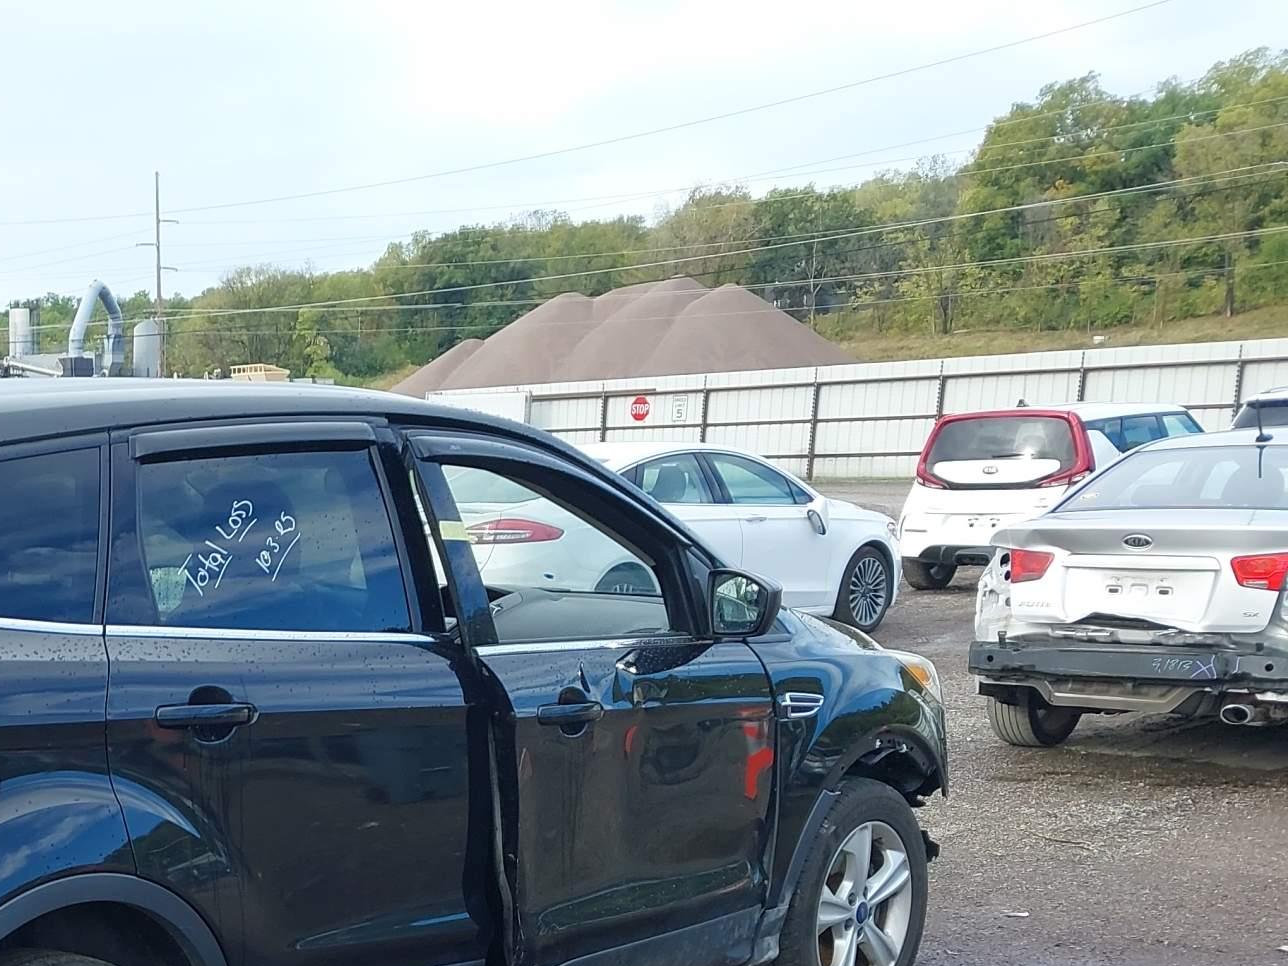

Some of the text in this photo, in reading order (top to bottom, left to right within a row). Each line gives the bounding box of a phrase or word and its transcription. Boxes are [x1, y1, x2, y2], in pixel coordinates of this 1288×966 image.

[631, 403, 650, 414] STOP
[676, 409, 683, 418] 5
[177, 500, 253, 597] Total Loss
